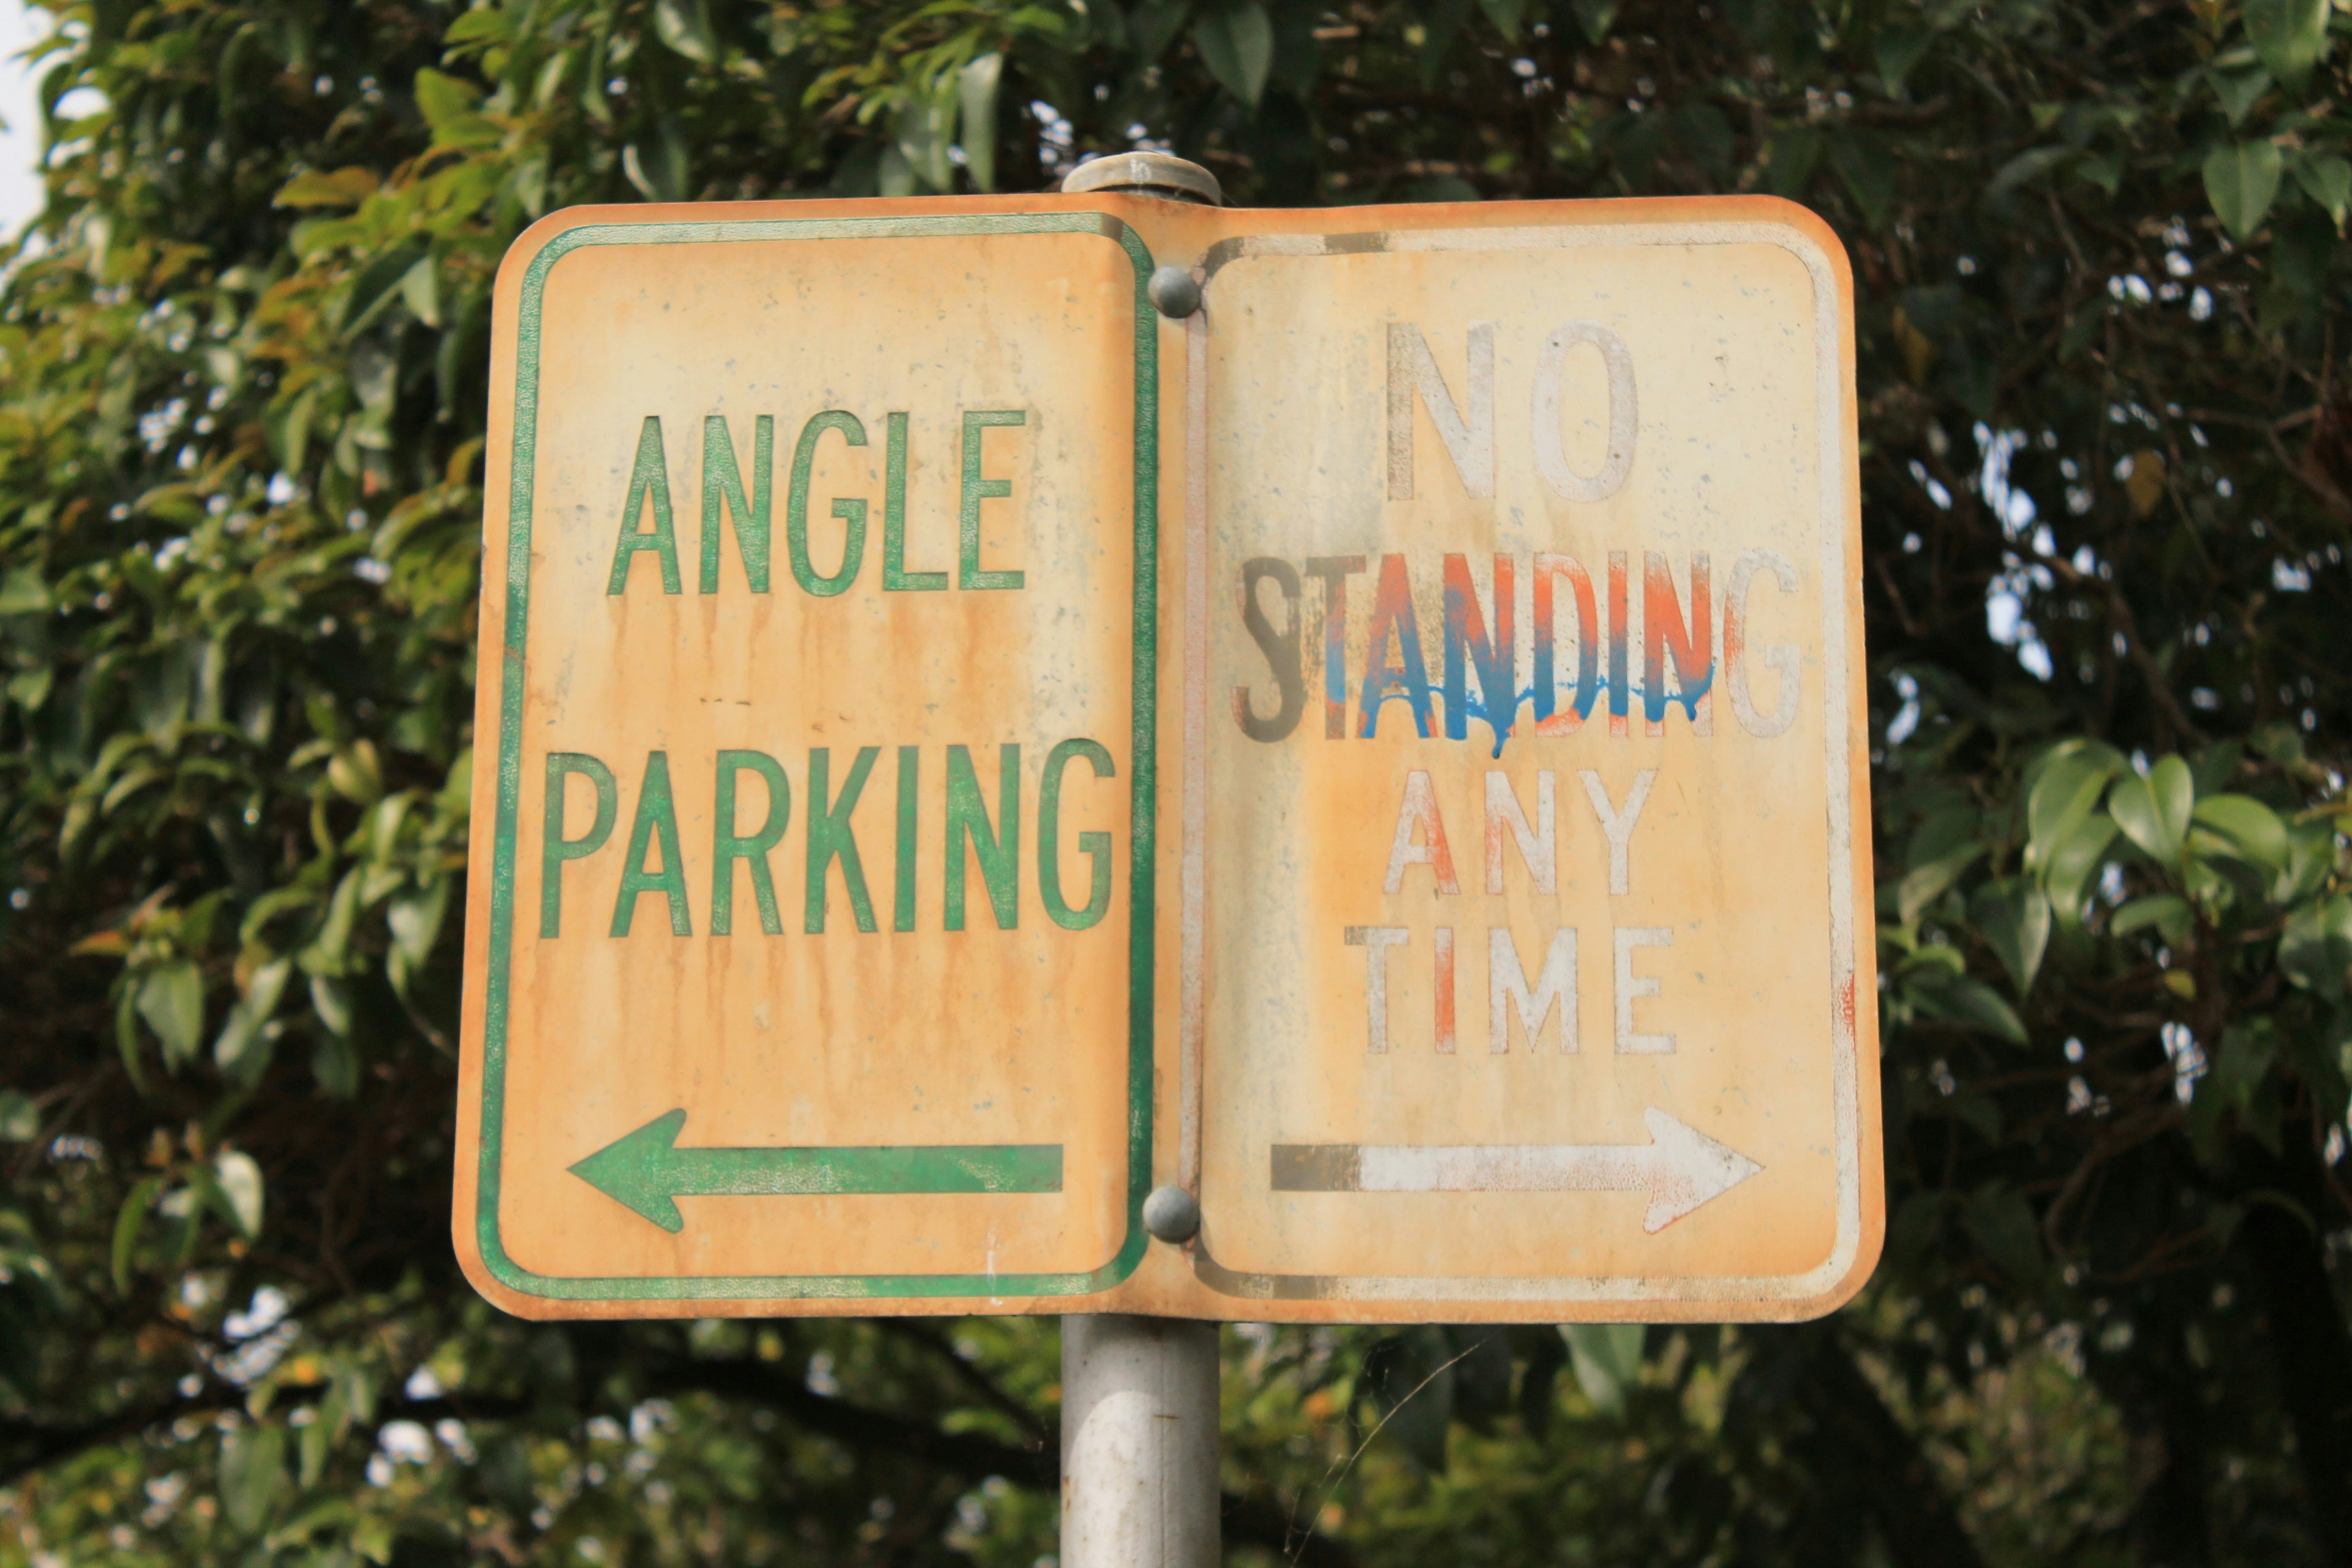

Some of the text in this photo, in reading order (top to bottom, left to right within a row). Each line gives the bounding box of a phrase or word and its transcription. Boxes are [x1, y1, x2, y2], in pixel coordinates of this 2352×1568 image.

[606, 410, 1026, 597] ANGLE
[1387, 319, 1638, 503] NO
[1231, 551, 1801, 743] STANDING
[540, 738, 1116, 939] PARKING
[1382, 769, 1658, 895] ANY
[1344, 926, 1676, 1055] TIME
